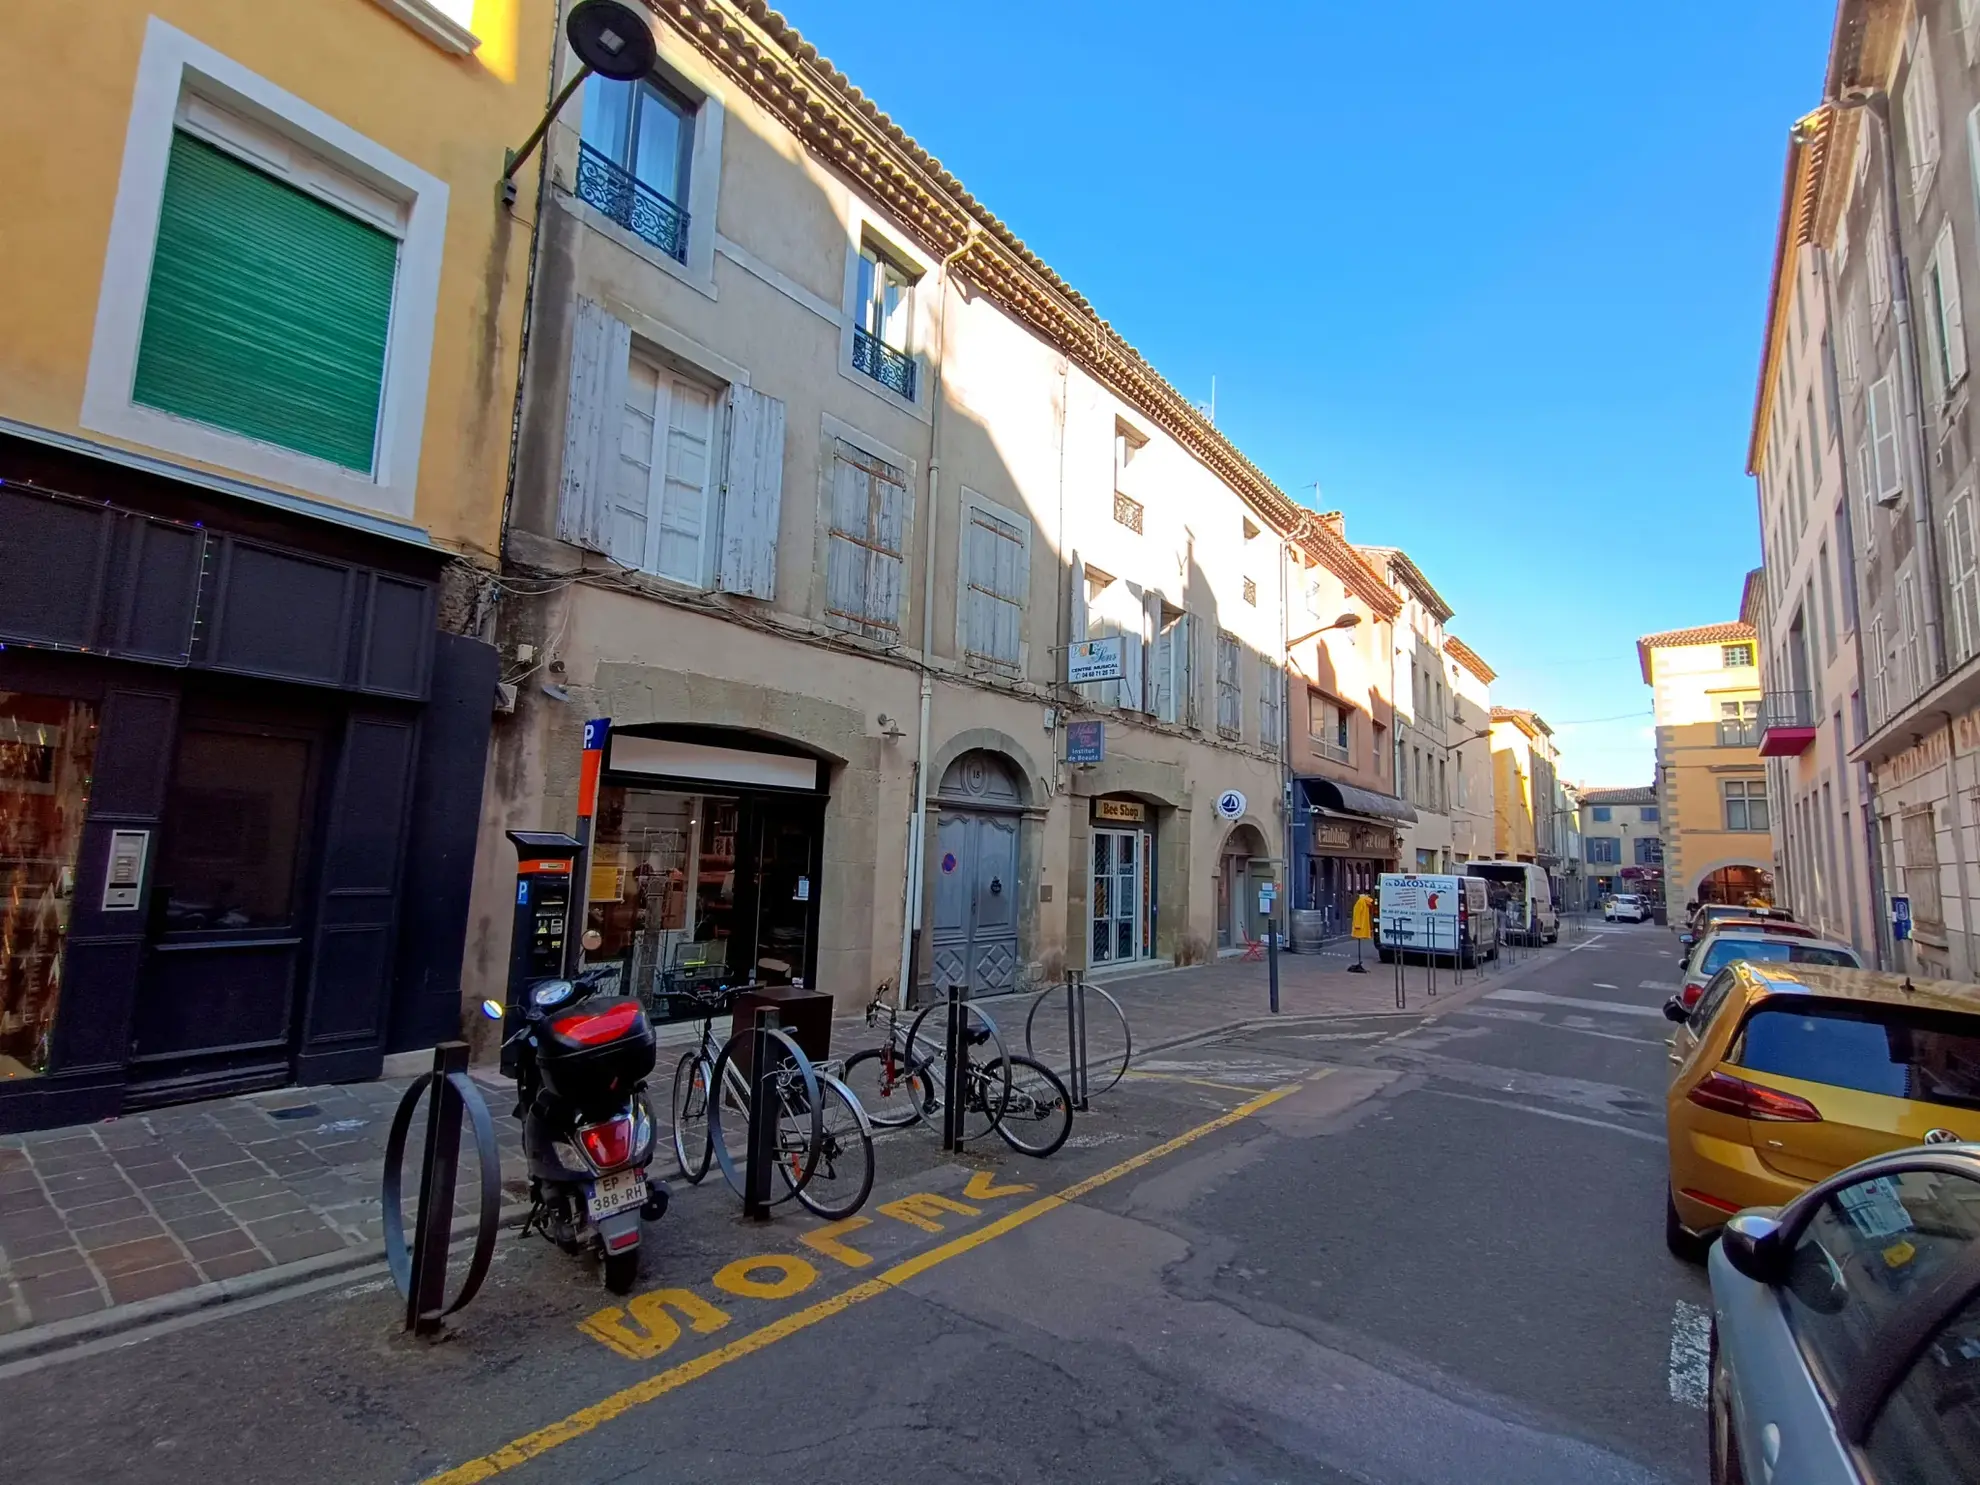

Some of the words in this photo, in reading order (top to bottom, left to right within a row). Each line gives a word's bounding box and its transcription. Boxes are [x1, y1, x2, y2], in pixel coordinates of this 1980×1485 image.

[584, 725, 595, 749] P
[1103, 802, 1119, 815] Bee
[1119, 804, 1139, 819] Shop
[518, 881, 528, 900] P
[1394, 880, 1436, 889] DACOSTA
[594, 1185, 642, 1211] 388-RH
[577, 1171, 1038, 1360] VELOS
